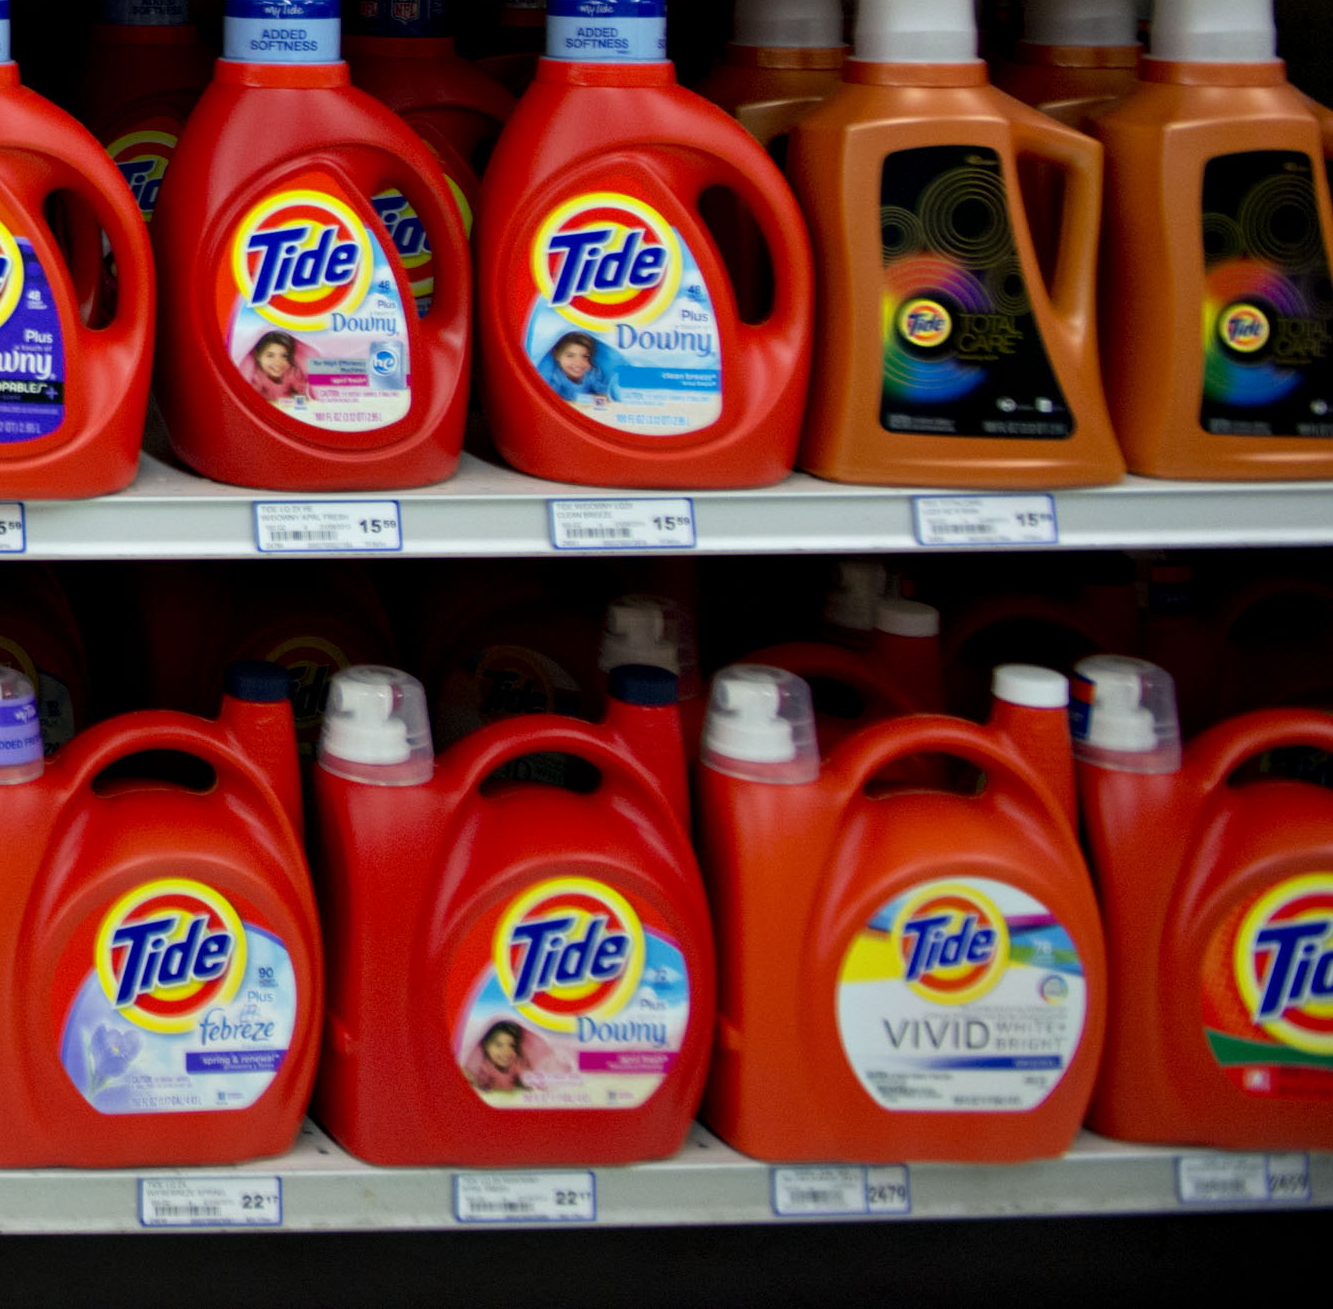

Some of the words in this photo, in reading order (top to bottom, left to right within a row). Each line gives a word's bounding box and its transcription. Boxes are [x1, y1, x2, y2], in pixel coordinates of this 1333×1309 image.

[250, 39, 318, 53] SOFTNESS
[261, 28, 307, 42] ADDED
[565, 37, 629, 51] SOFTNESS
[576, 27, 618, 40] ADDED
[247, 224, 360, 308] Tide
[548, 228, 668, 307] Tide
[331, 312, 397, 336] Downy
[681, 310, 708, 323] Plus
[905, 312, 946, 336] Tide
[25, 330, 53, 344] Plus
[616, 323, 712, 357] Downy
[110, 915, 232, 1008] Tide
[508, 915, 631, 1007] Tide
[903, 915, 997, 983] Tide
[199, 1009, 275, 1046] febreze
[576, 1015, 667, 1046] Downy
[882, 1019, 991, 1050] VIVID
